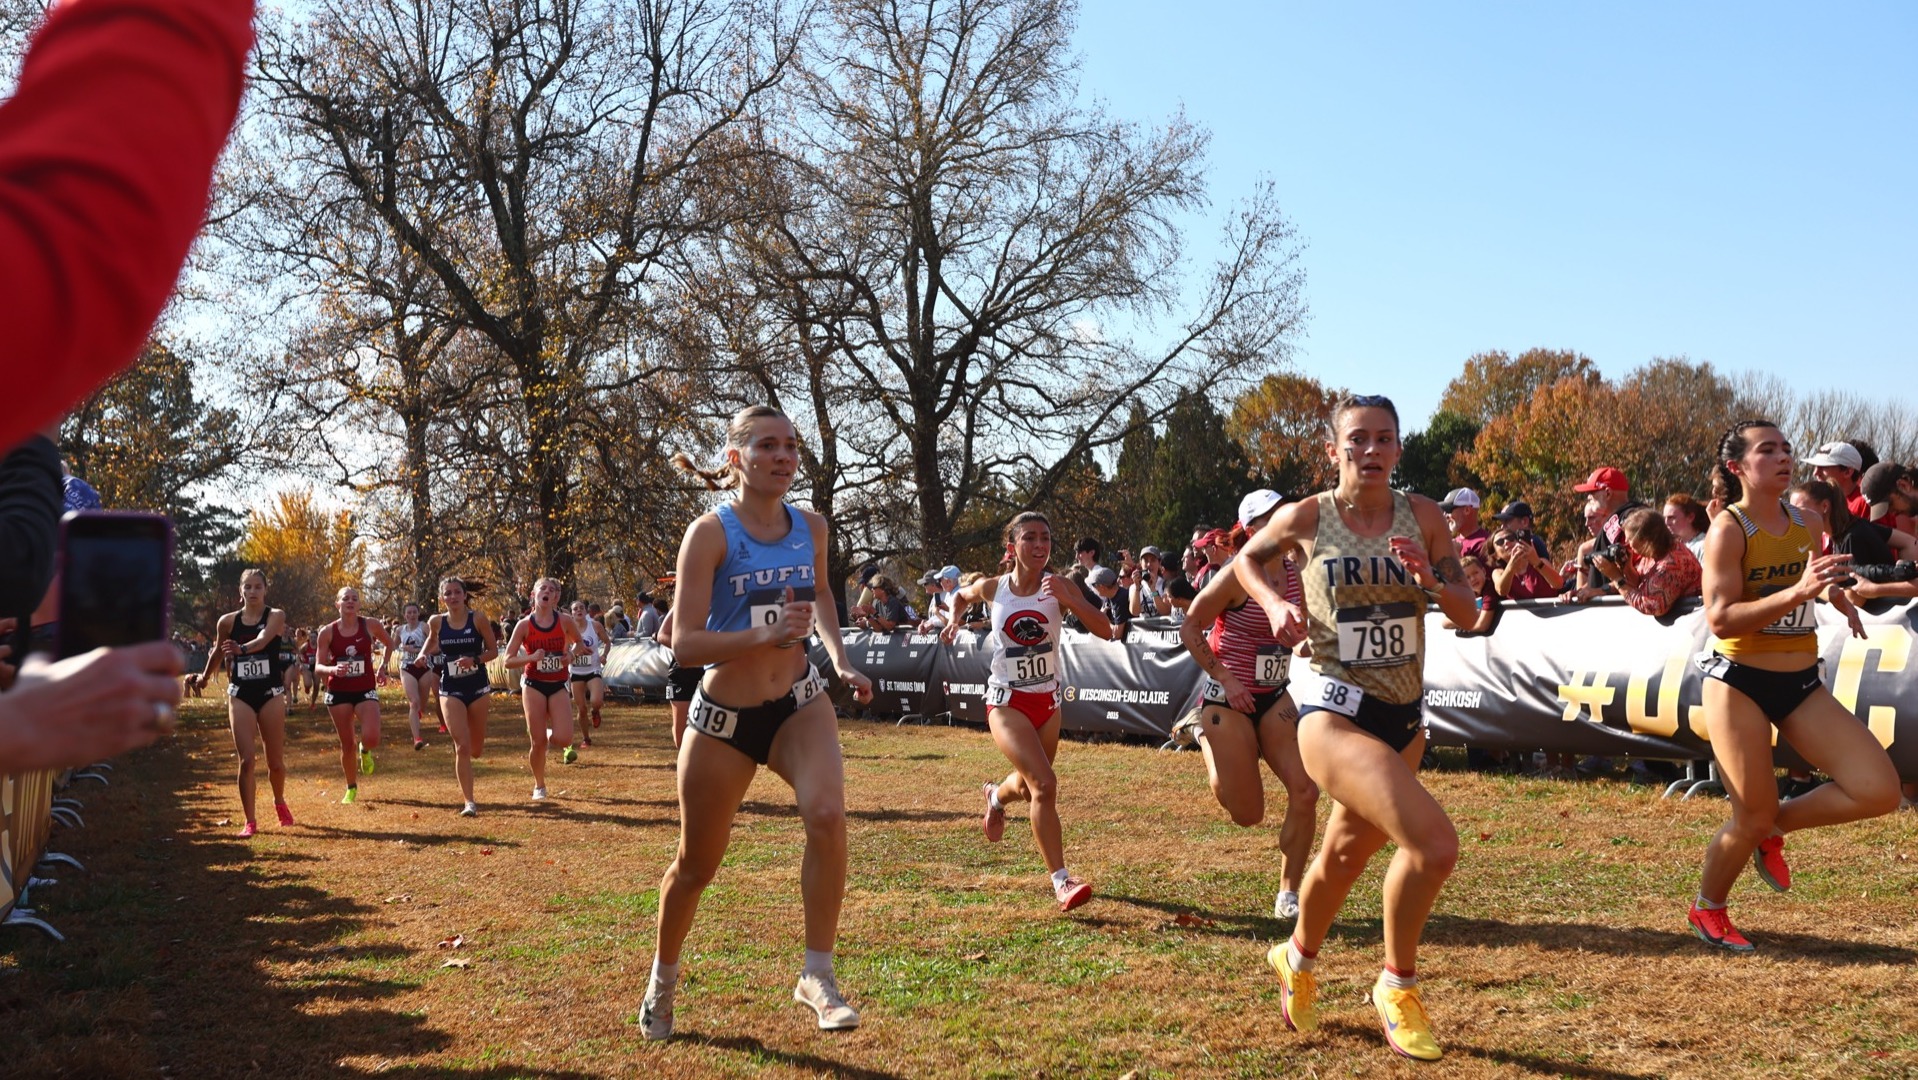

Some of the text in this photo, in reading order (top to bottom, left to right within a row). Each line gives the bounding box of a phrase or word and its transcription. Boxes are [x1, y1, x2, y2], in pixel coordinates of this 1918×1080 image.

[1323, 556, 1417, 587] TRIN
[1748, 560, 1807, 581] EMO
[1772, 602, 1808, 627] 97
[1352, 624, 1405, 660] 798
[243, 662, 263, 677] 501
[541, 657, 560, 671] 530
[1016, 657, 1047, 680] 510
[1264, 658, 1288, 680] 875
[894, 681, 914, 692] THOMAS
[960, 683, 986, 695] CORTLAND
[1079, 688, 1170, 705] WISCONSIN-EAU CLAIRE
[693, 699, 728, 733] 819
